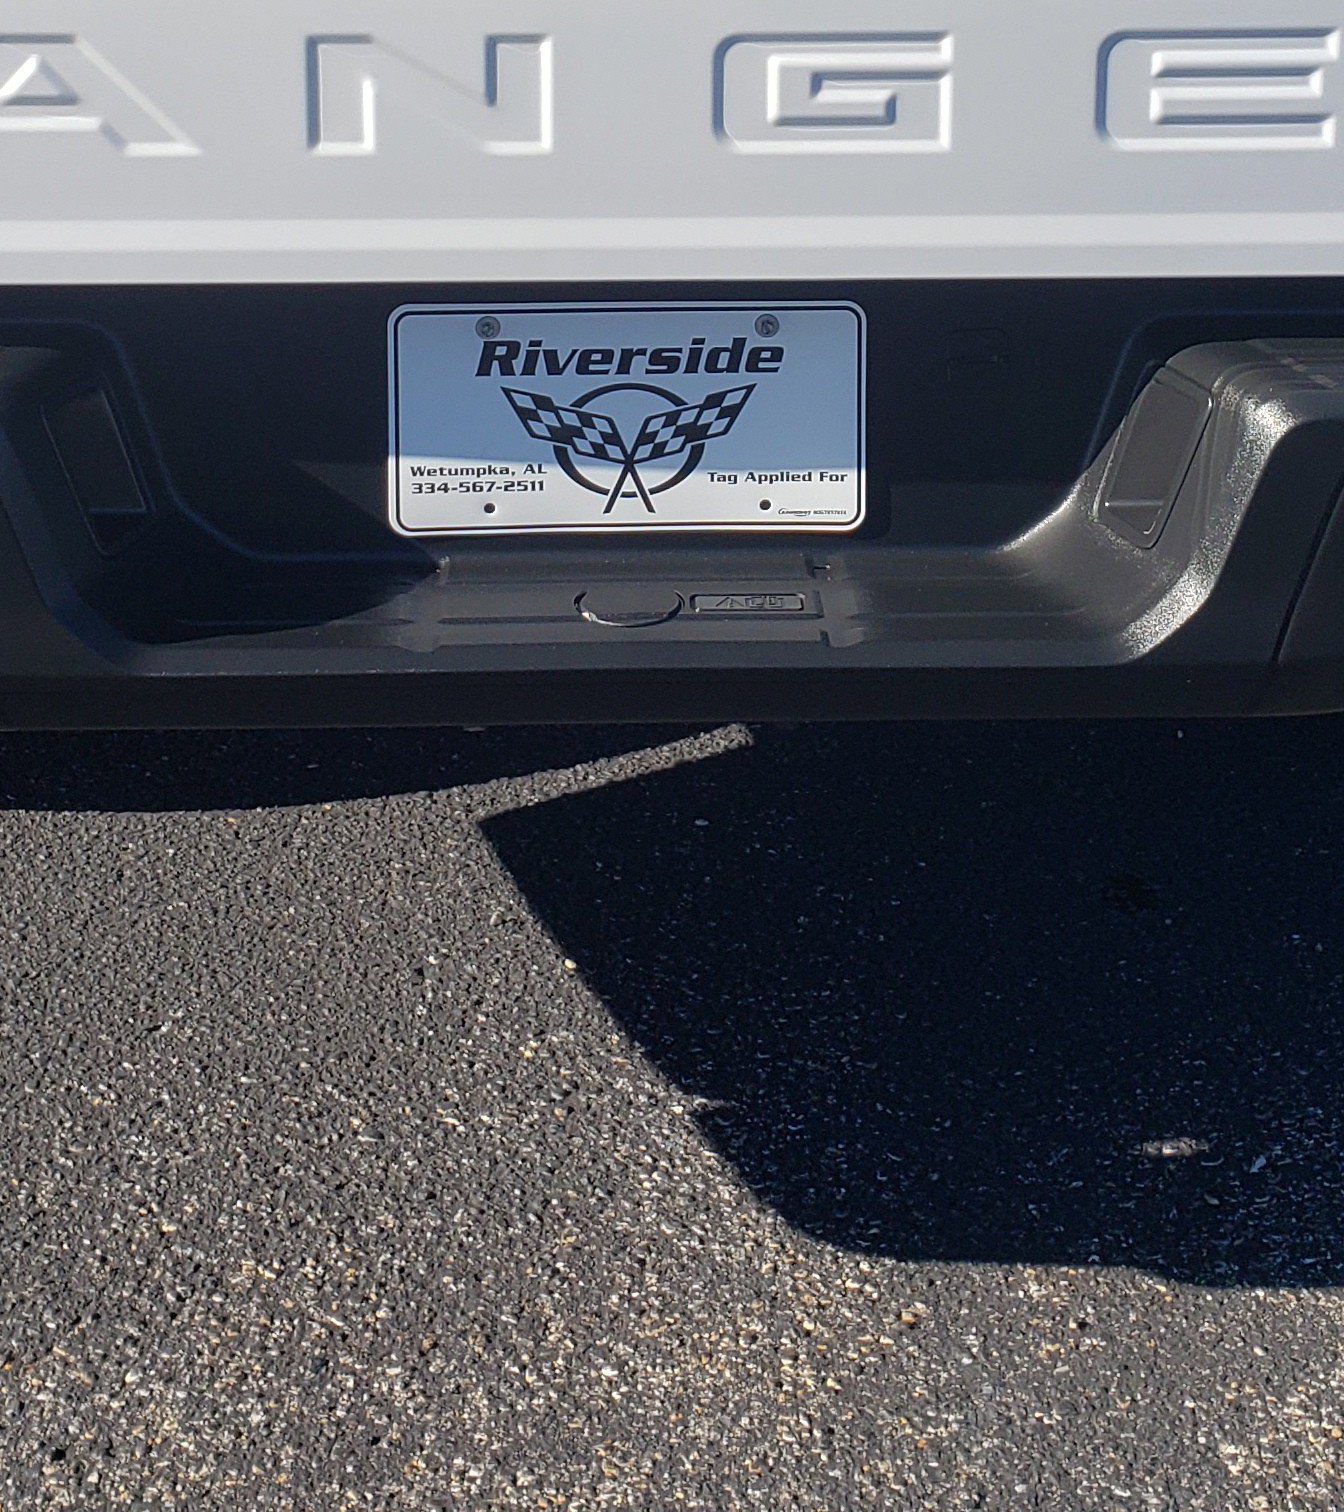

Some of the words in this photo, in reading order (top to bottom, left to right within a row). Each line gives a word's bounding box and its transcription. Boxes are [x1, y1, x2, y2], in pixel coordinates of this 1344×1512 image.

[475, 337, 785, 377] Riverside
[410, 465, 516, 478] Wetumpka,
[523, 463, 548, 475] AL
[707, 471, 738, 485] Tag
[744, 471, 812, 485] Applied
[819, 471, 848, 482] For
[411, 480, 545, 494] 334-567-2511
